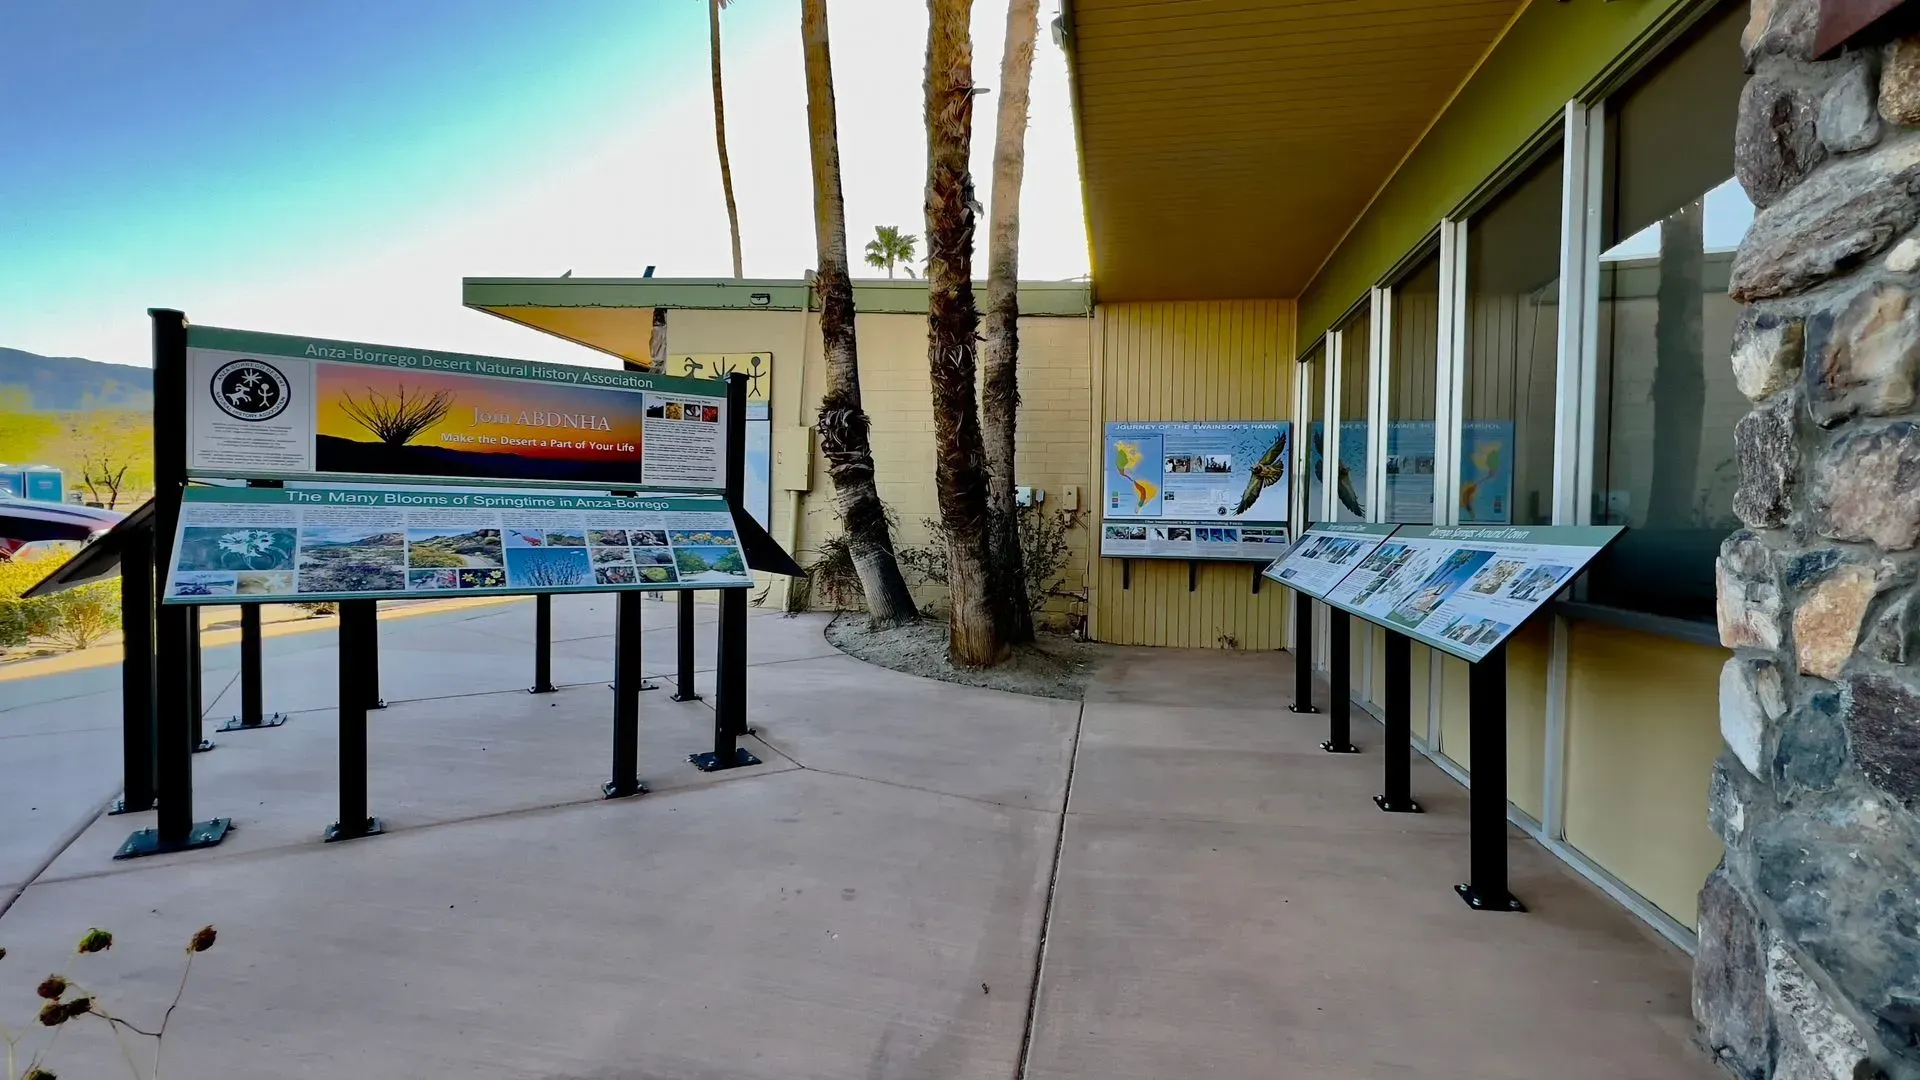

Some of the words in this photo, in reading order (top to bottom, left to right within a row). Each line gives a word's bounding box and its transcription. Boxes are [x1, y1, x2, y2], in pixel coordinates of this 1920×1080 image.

[305, 343, 417, 367] Anza-Borrego
[422, 355, 471, 372] Desert
[475, 360, 528, 377] Natural
[532, 366, 579, 384] History
[582, 371, 653, 389] Association
[471, 406, 512, 428] Join
[515, 410, 611, 432] ABDNHA
[441, 432, 474, 444] Make
[478, 433, 497, 444] the
[501, 435, 537, 447] Desert
[551, 439, 572, 450] Part
[575, 440, 586, 450] of
[589, 441, 614, 452] Your
[617, 442, 635, 453] Life
[286, 490, 322, 503] The
[328, 491, 379, 506] Many
[384, 492, 448, 505] Blooms
[452, 495, 469, 506] of
[474, 495, 555, 508] Springtime
[559, 497, 573, 507] in
[576, 499, 669, 511] Anza-Borrego
[1475, 528, 1507, 538] Around
[1504, 528, 1531, 539] Town
